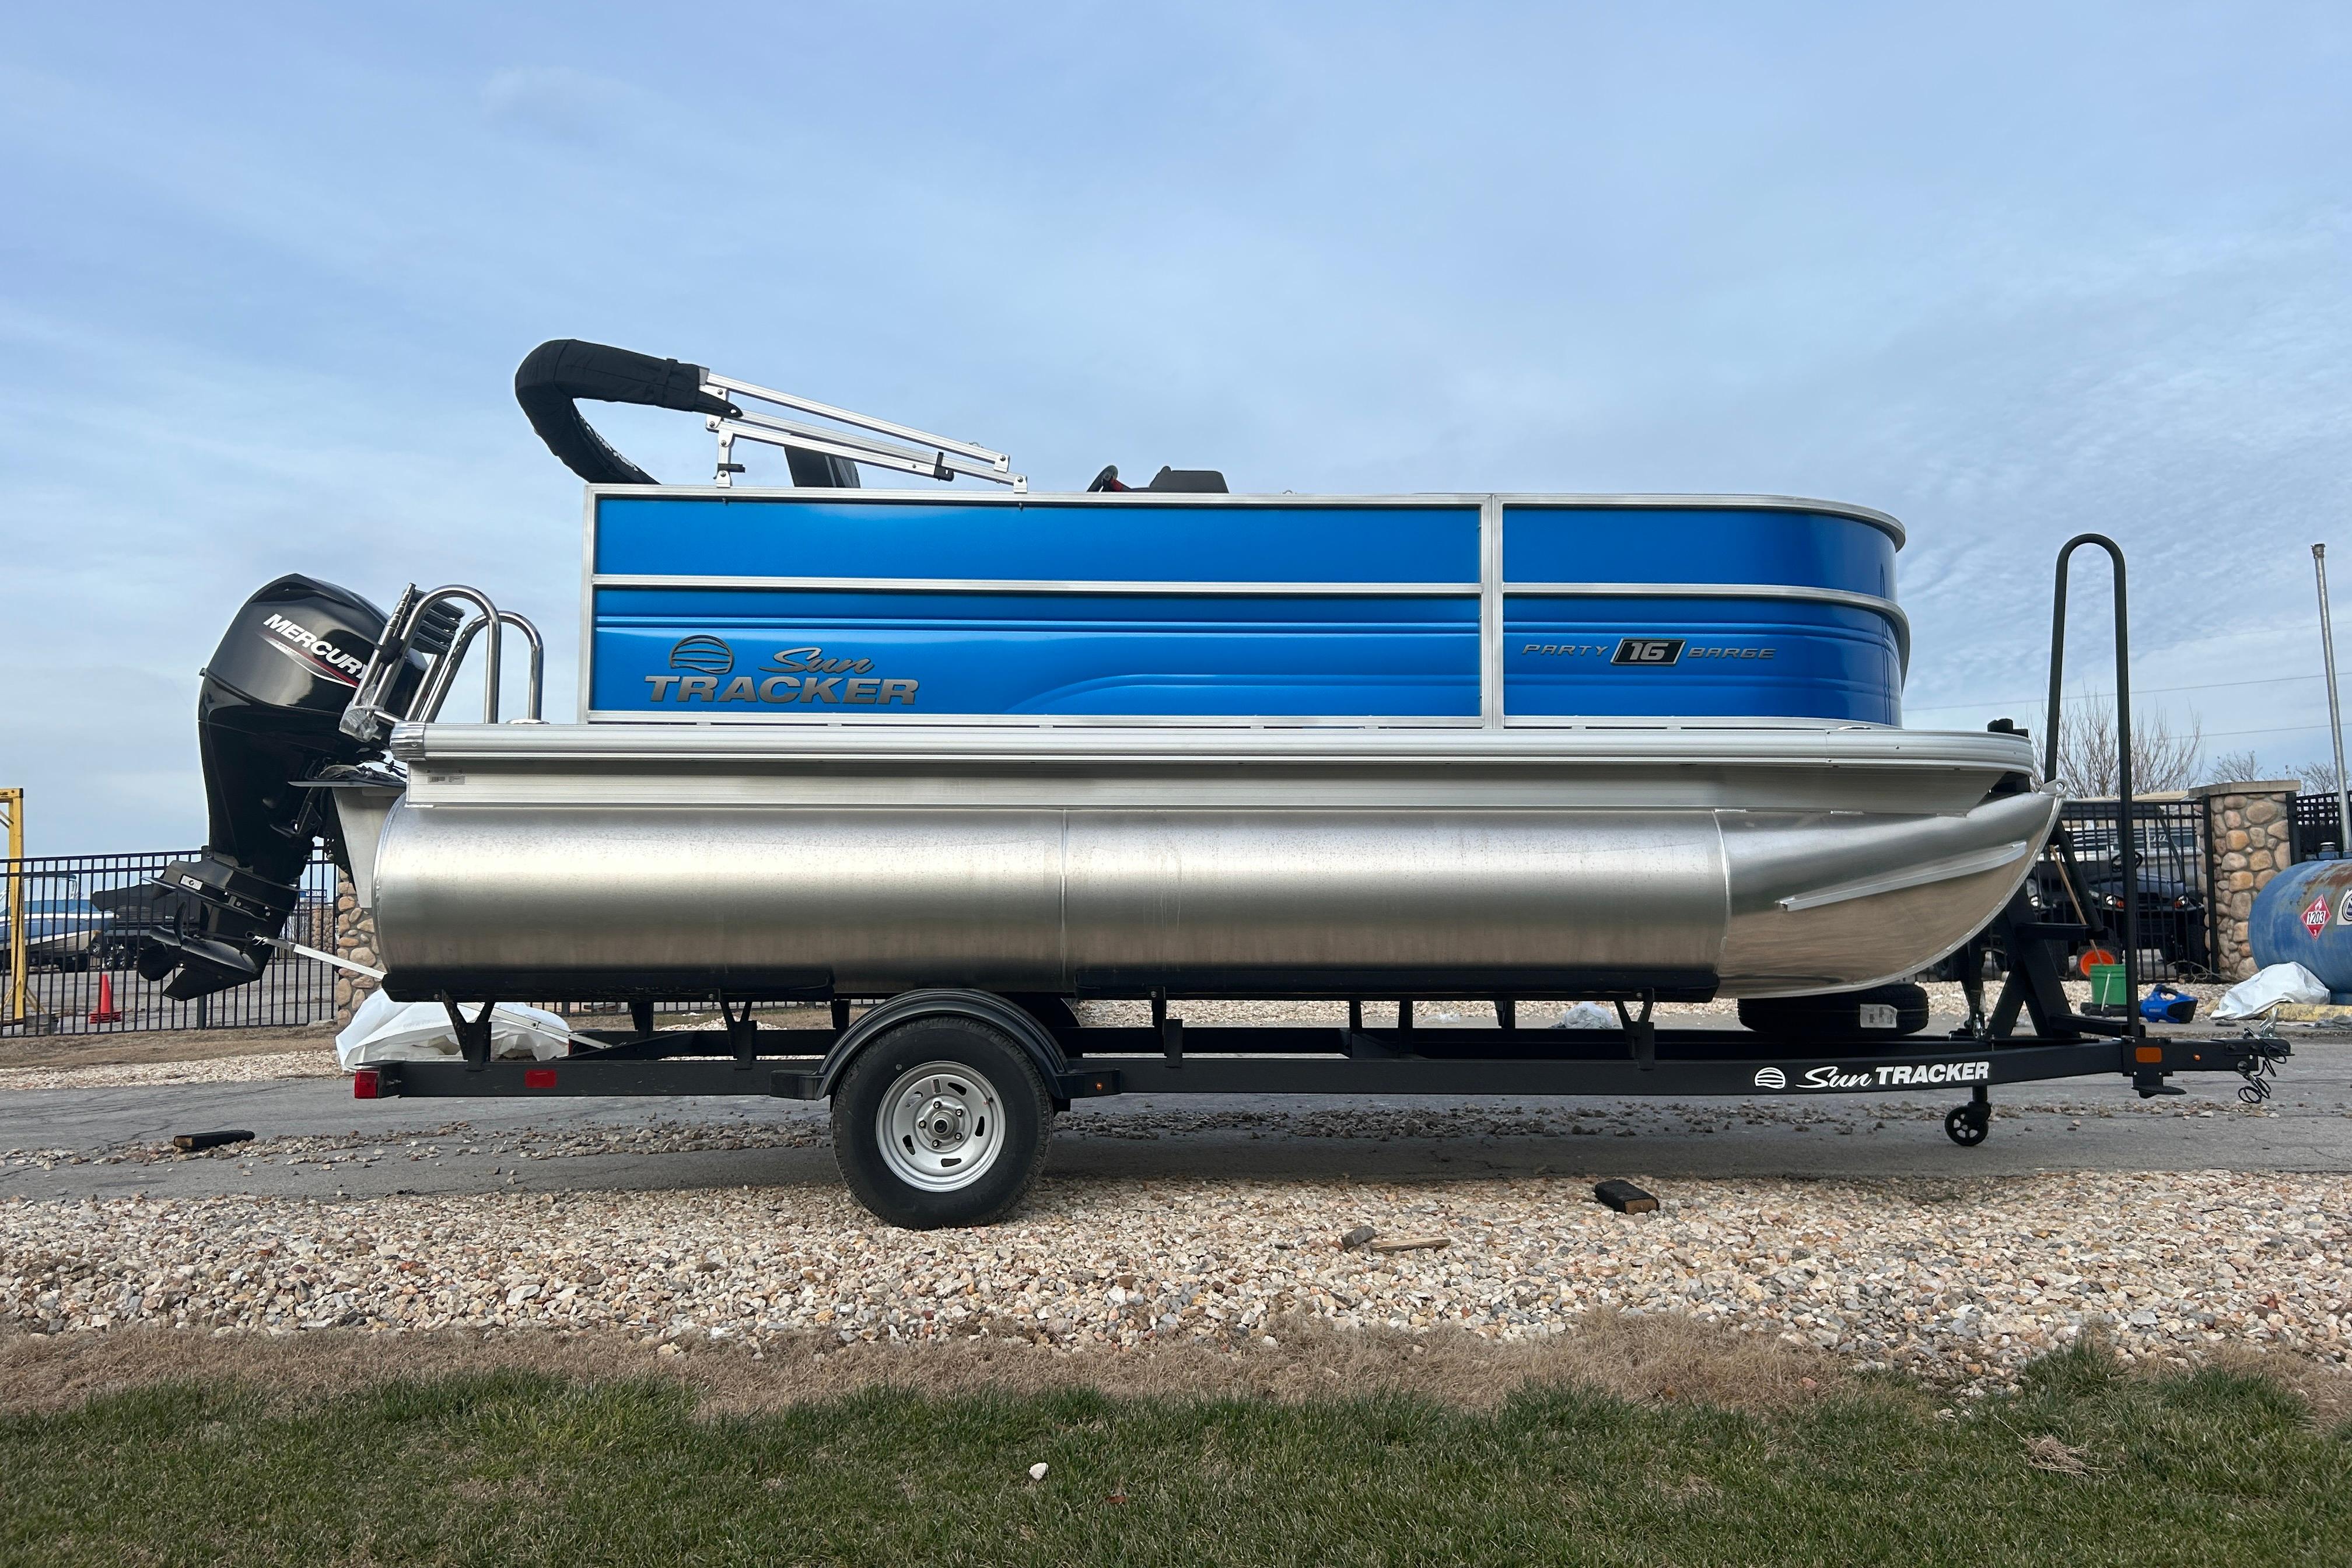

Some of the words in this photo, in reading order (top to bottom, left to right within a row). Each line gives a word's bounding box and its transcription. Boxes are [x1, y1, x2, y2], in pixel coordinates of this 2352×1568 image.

[758, 647, 875, 674] Sun
[1522, 644, 1609, 656] PARTY
[1629, 642, 1669, 660] 16
[1686, 648, 1777, 659] BARGE
[645, 675, 919, 705] TRACKER
[2308, 911, 2325, 924] 1203
[1795, 1066, 1873, 1088] Sun
[1875, 1061, 1990, 1085] TRACKER
